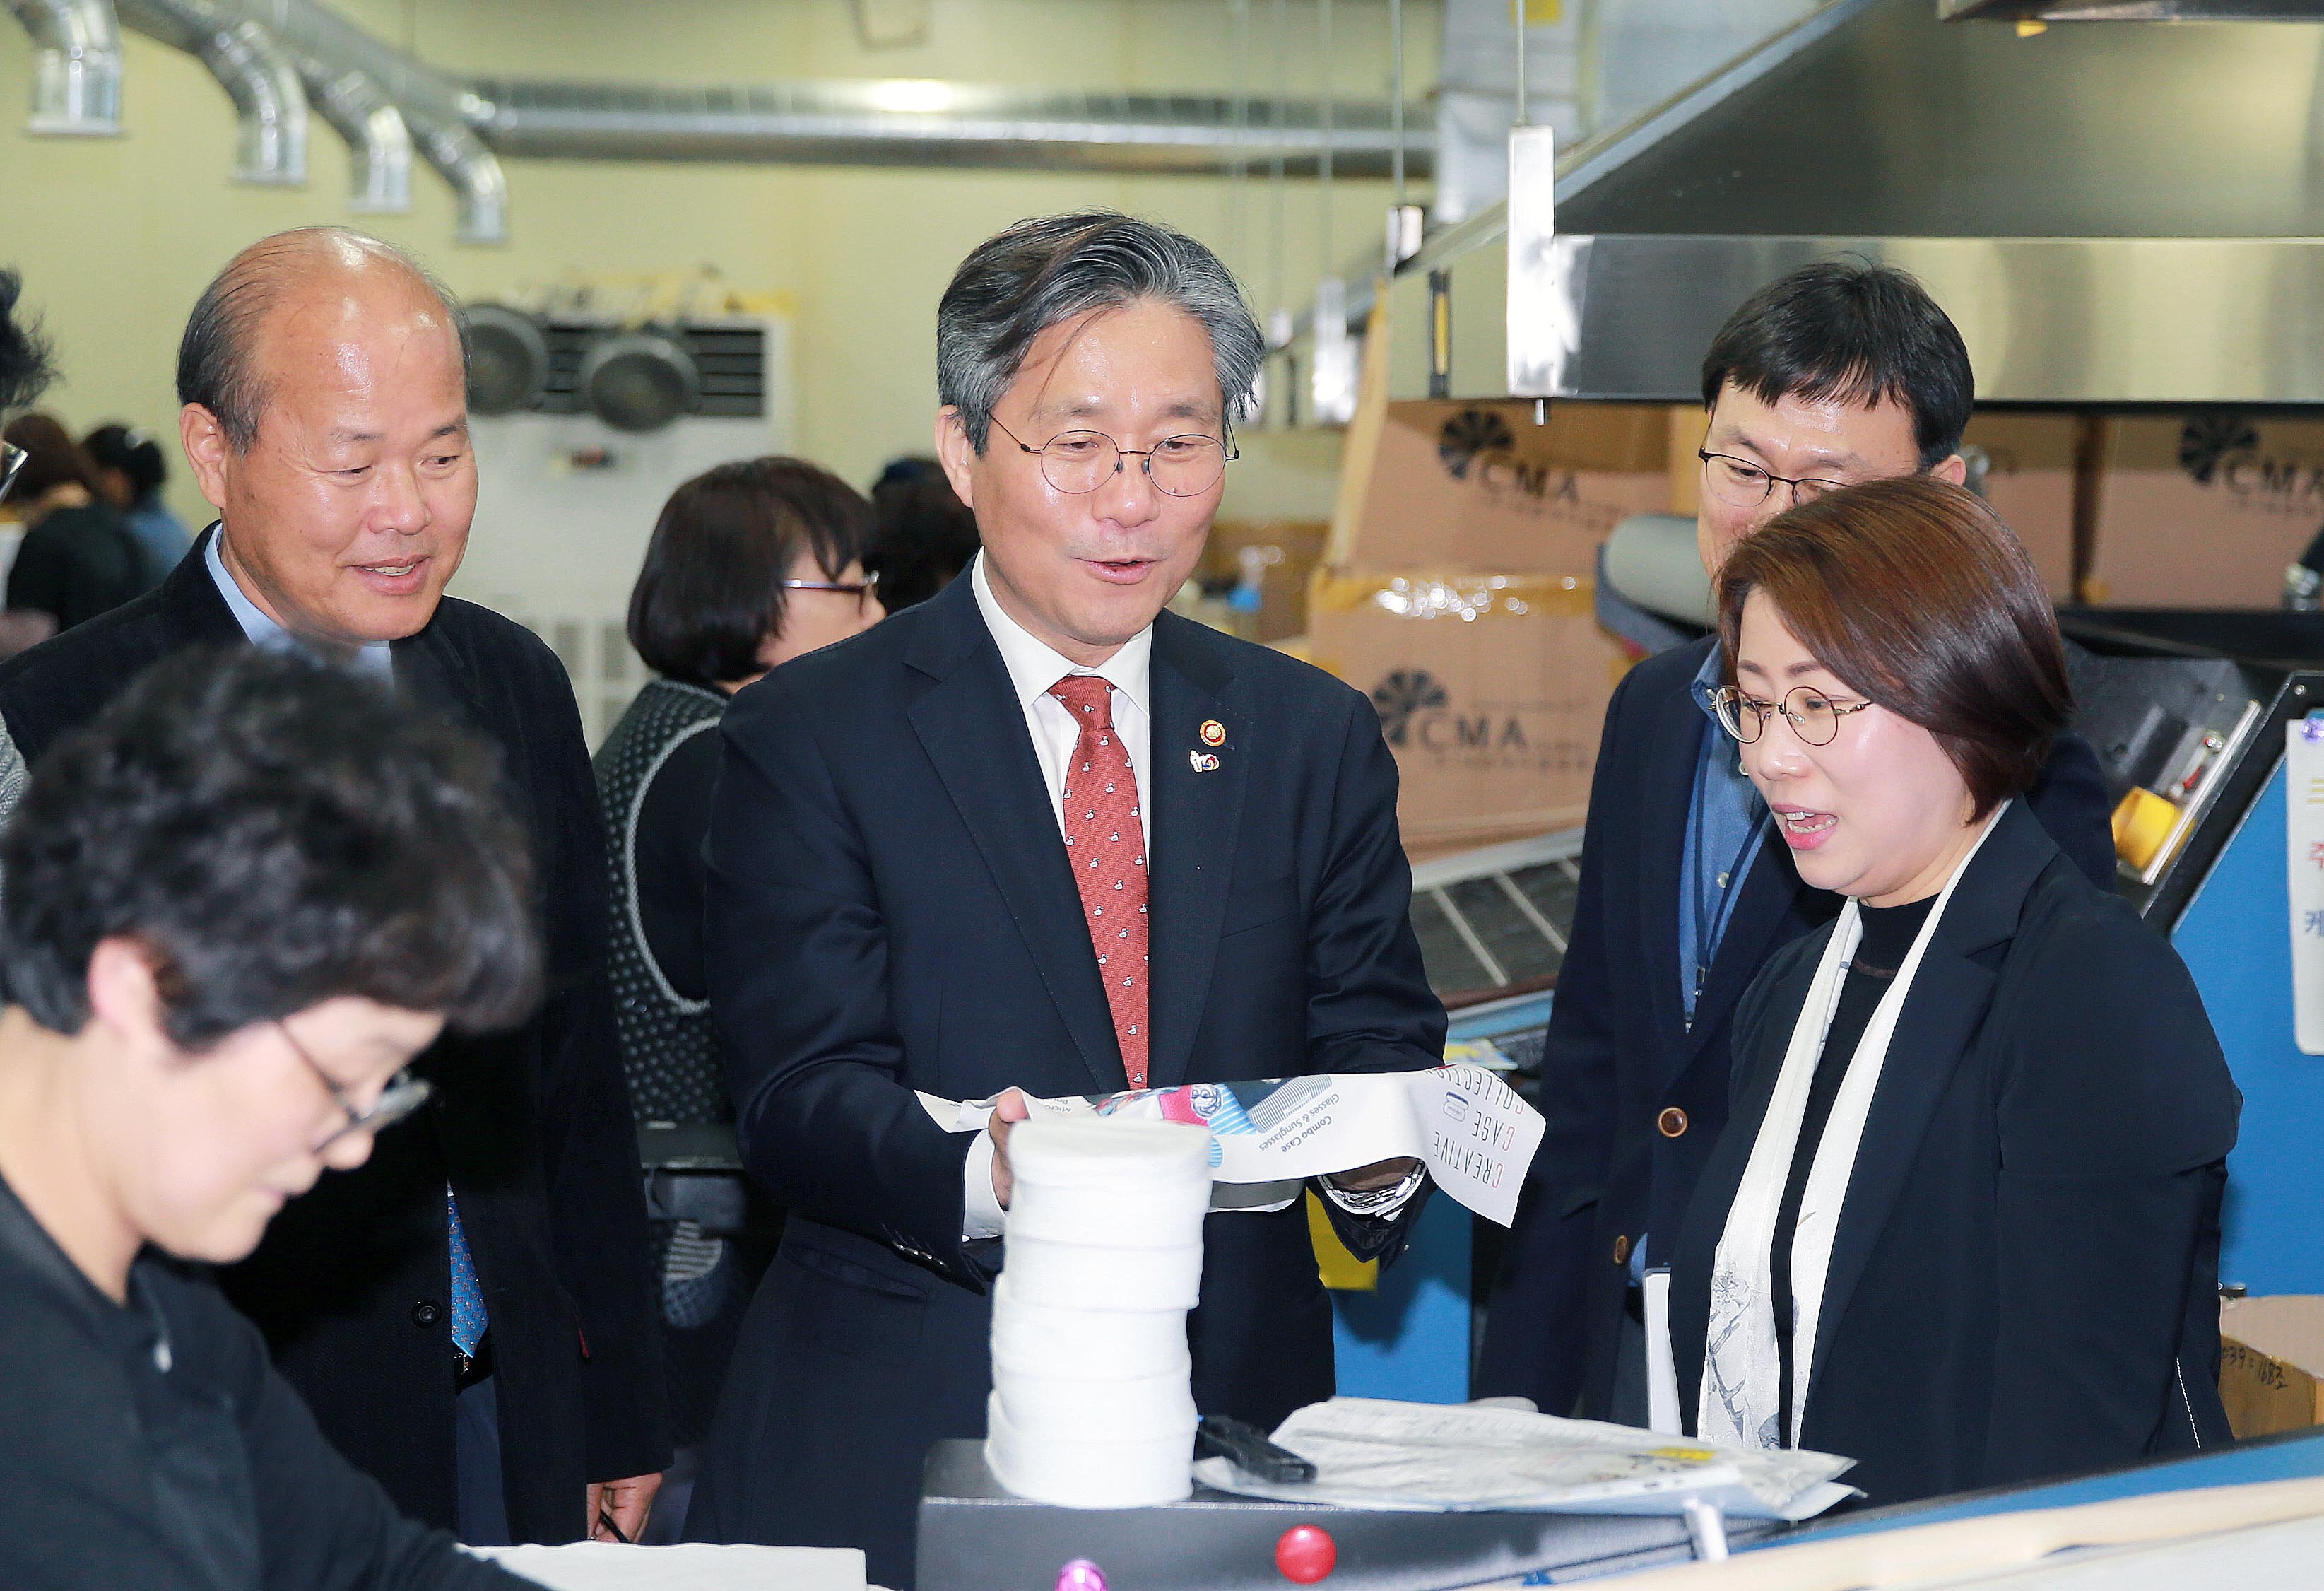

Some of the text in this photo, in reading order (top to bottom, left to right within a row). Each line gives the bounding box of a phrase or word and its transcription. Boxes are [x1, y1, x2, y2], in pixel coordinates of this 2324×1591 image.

[1481, 452, 1580, 503] CMA
[1418, 712, 1528, 753] CMA
[1302, 1113, 1311, 1122] &
[1309, 1093, 1340, 1117] Glasses
[1258, 1118, 1303, 1151] Sunglasses
[1280, 1115, 1332, 1153] Combo Case
[1471, 1110, 1516, 1152] CASE
[1434, 1132, 1503, 1188] CREATIVE
